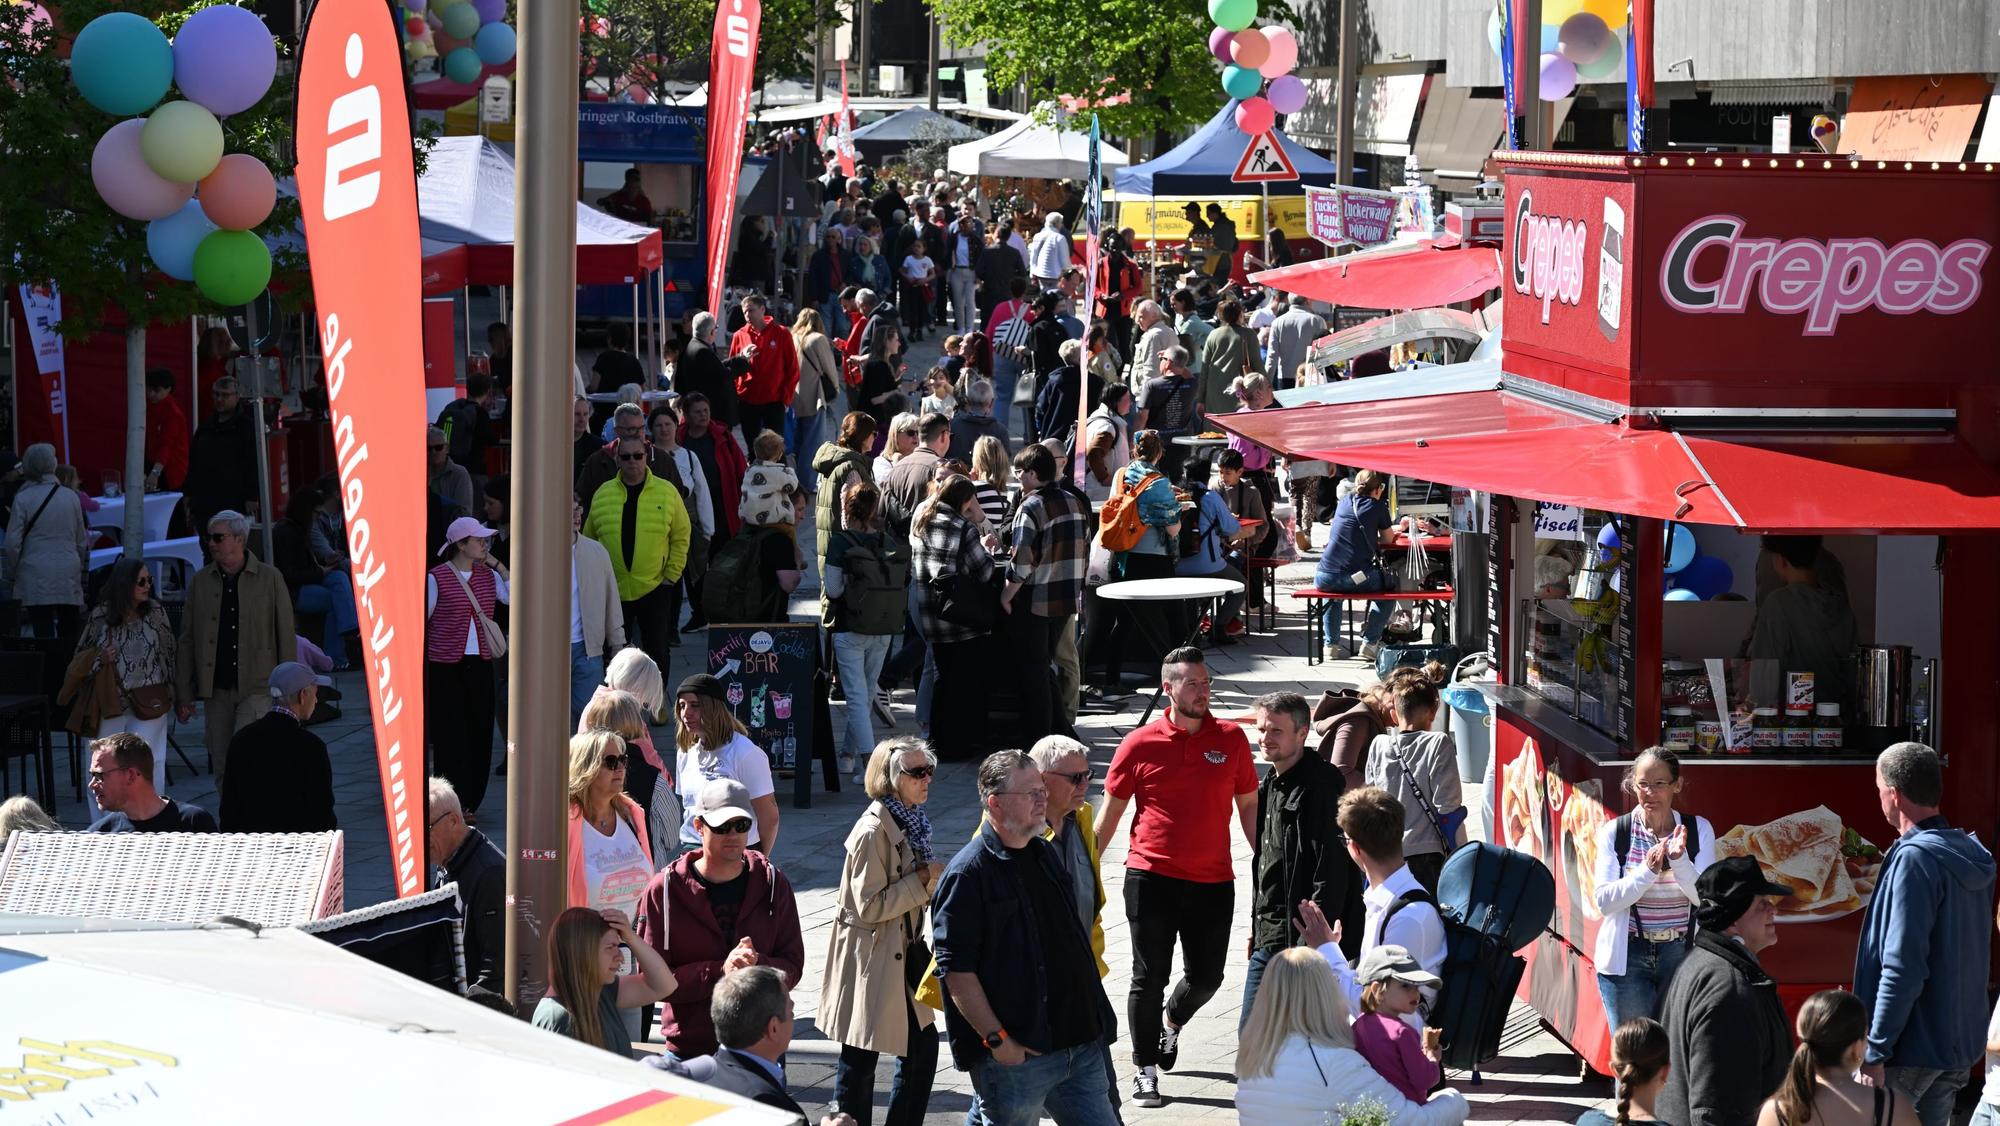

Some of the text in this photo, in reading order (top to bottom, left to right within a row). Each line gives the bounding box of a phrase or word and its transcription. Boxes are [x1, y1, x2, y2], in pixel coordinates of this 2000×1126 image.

[1314, 201, 1338, 213] Zucke
[1343, 200, 1391, 222] Zuckerwatte
[1348, 224, 1384, 240] POPCORN
[1513, 189, 1587, 325] Crepes
[1660, 215, 1992, 336] Crepes
[744, 652, 779, 674] BAR
